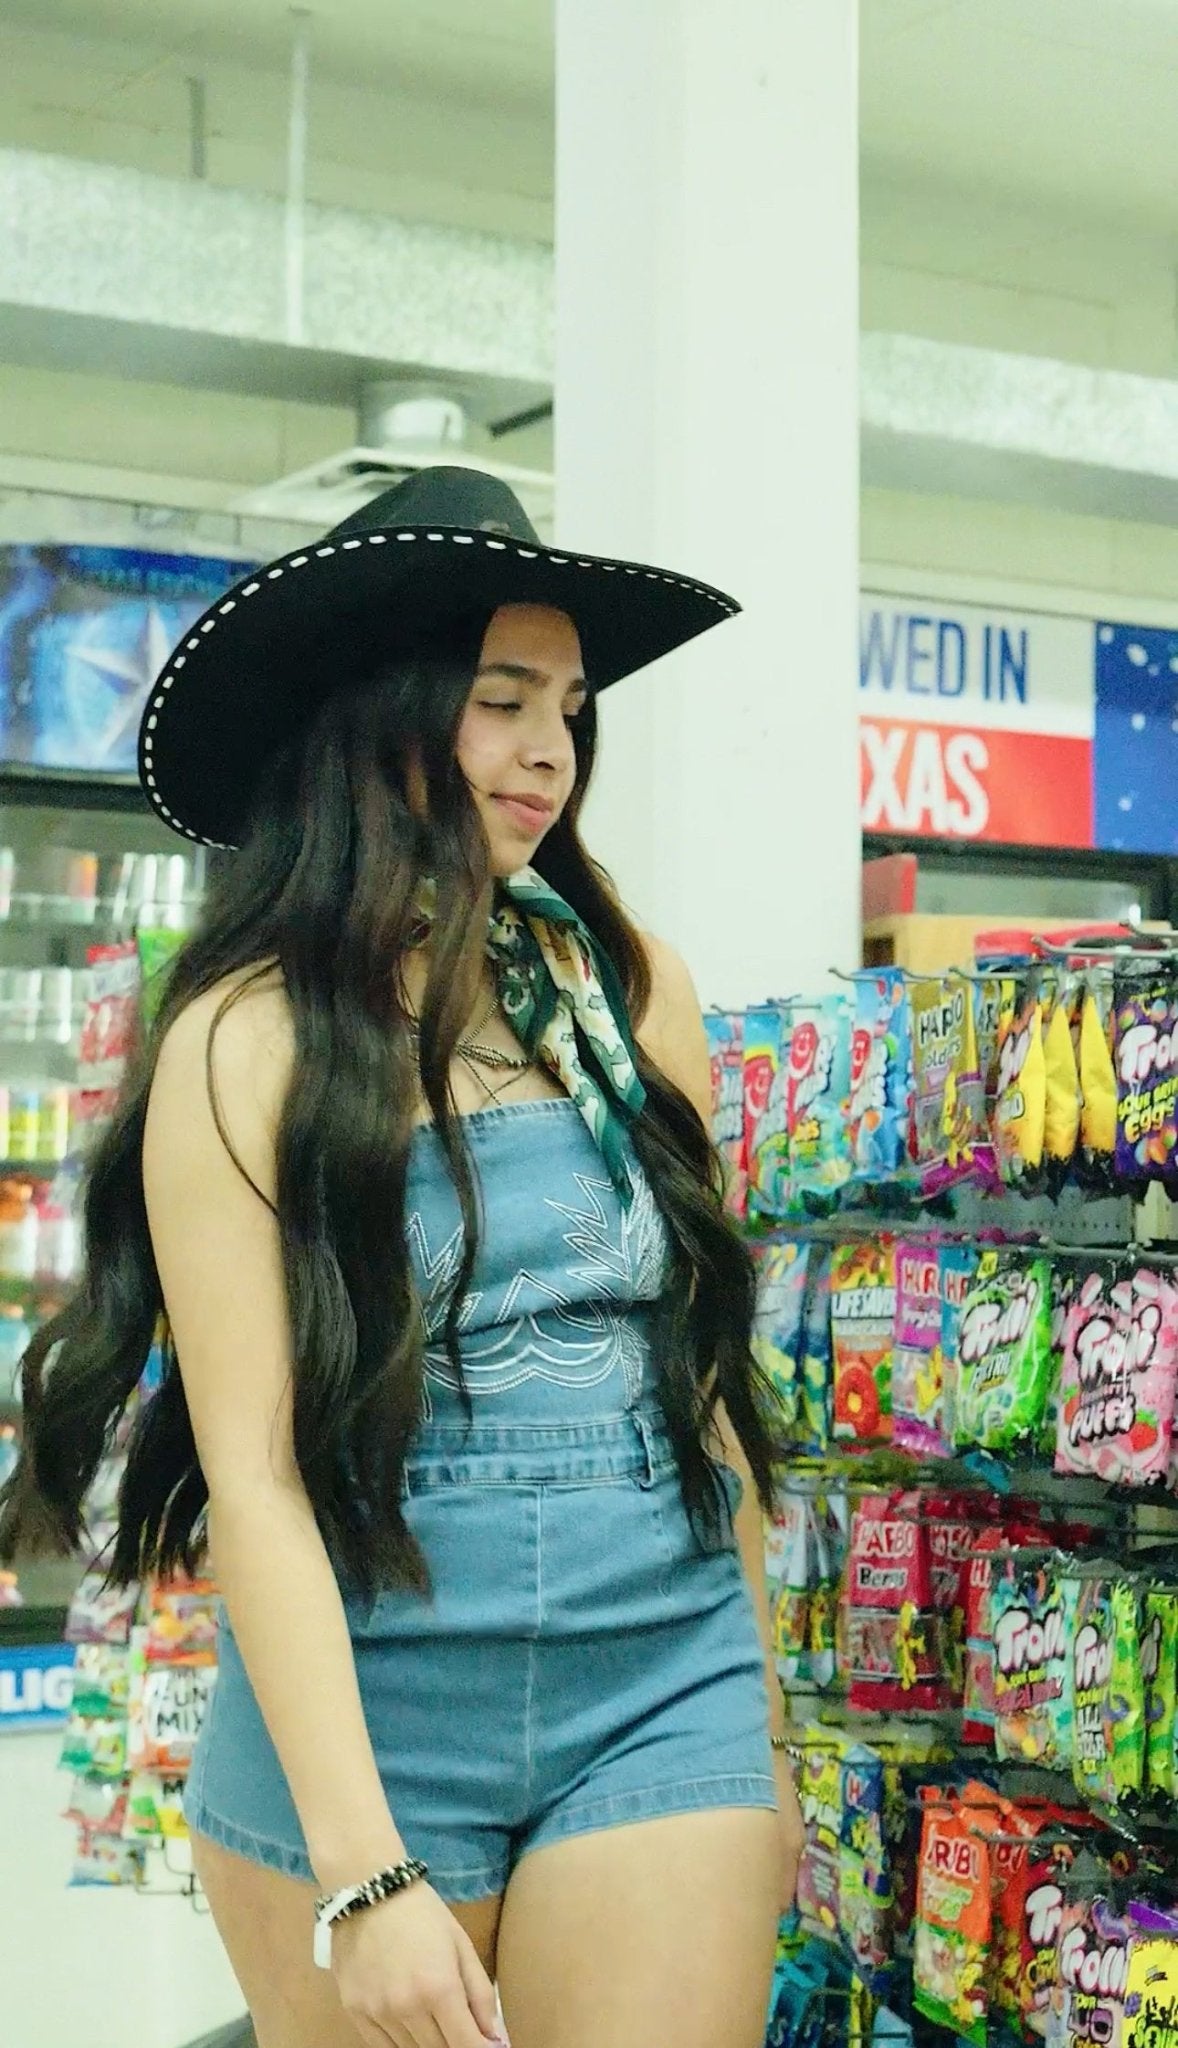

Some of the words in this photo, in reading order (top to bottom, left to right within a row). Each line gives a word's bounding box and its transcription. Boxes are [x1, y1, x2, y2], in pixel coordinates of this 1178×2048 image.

[859, 610, 966, 698] WED
[985, 624, 1029, 704] IN
[859, 723, 989, 837] XAS
